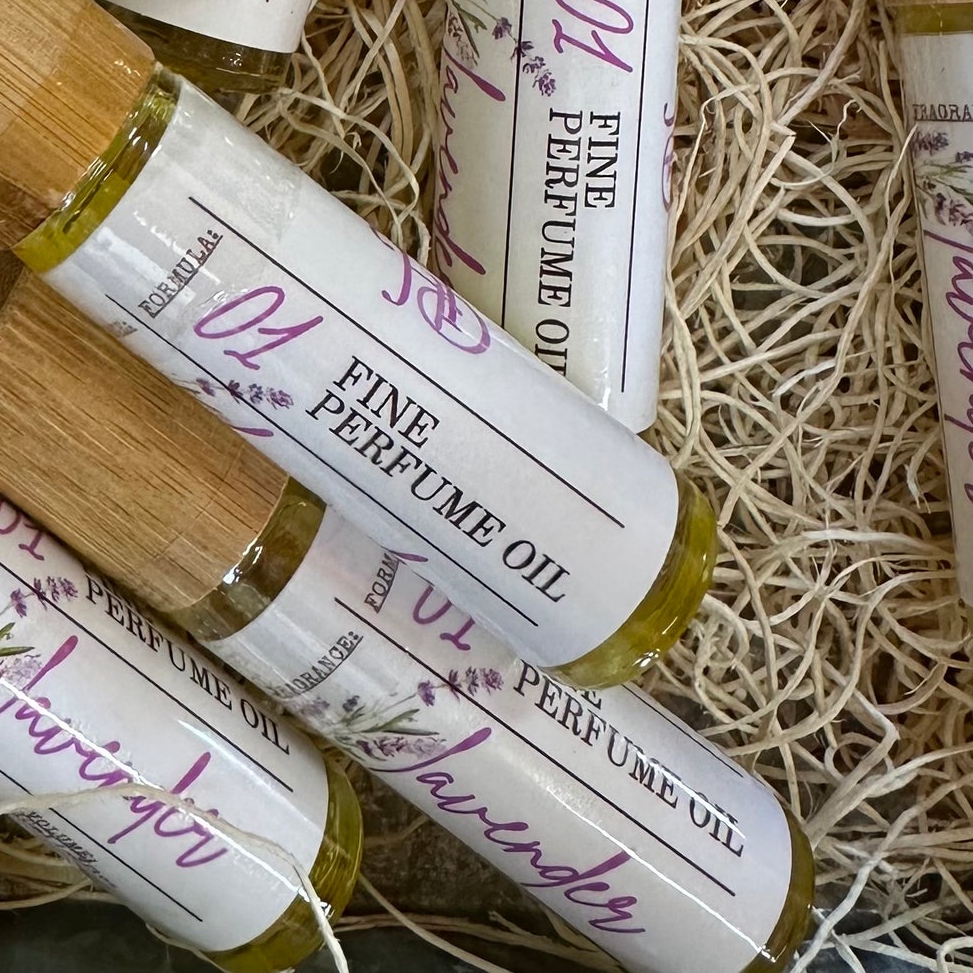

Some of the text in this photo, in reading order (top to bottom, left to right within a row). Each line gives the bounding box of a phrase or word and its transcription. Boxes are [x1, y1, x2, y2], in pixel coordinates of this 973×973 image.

[537, 107, 583, 309] PERFUME
[583, 111, 621, 211] FINE
[138, 228, 223, 318] FORMULA:
[193, 285, 323, 371] 01
[331, 355, 441, 450] FINE
[305, 389, 572, 604] PERFUME OIL
[85, 576, 292, 756] PERFUME OIL
[370, 726, 646, 935] lavender
[513, 659, 746, 858] PERFUME OIL
